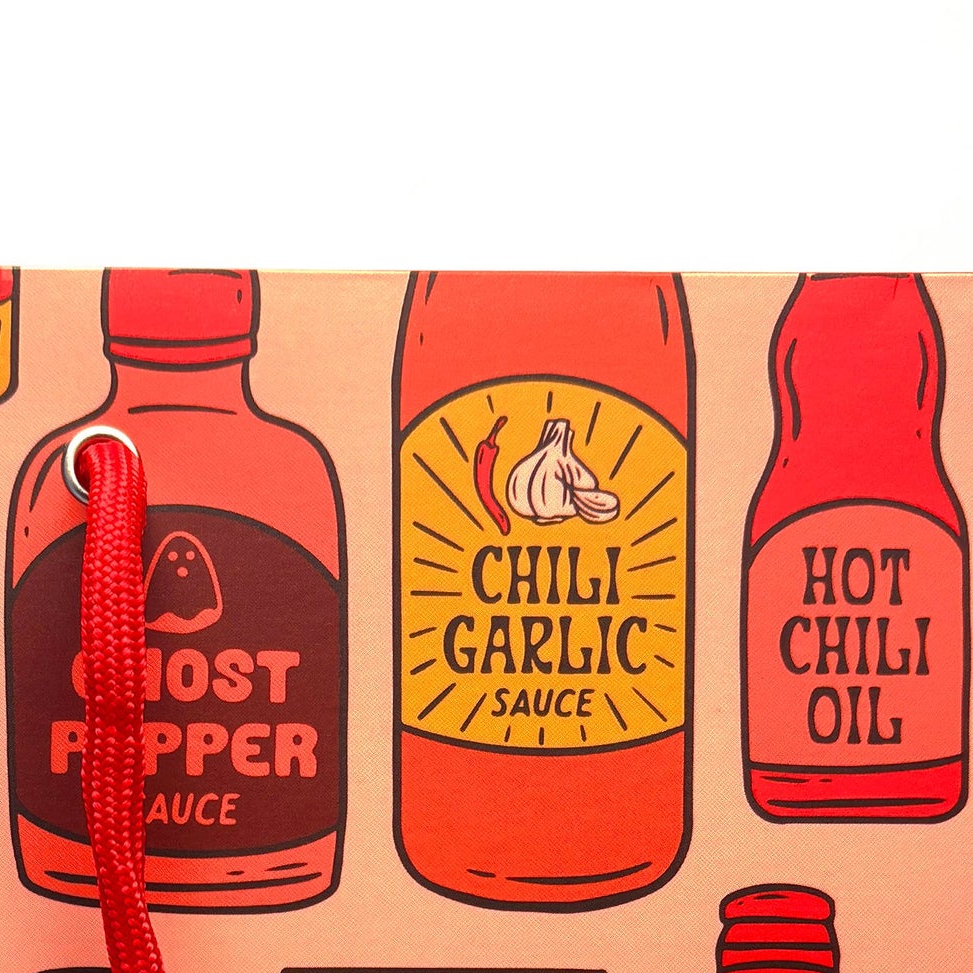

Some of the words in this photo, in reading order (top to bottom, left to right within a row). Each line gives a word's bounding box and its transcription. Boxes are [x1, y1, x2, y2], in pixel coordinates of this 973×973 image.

[471, 545, 621, 605] CHILI
[802, 546, 910, 606] HOT
[443, 615, 648, 675] GARLIC
[779, 615, 931, 676] CHILI
[71, 648, 300, 704] OST
[491, 687, 595, 718] SAUCE
[807, 686, 902, 745] OIL
[50, 721, 318, 778] PPPER
[143, 792, 241, 826] AUCE
